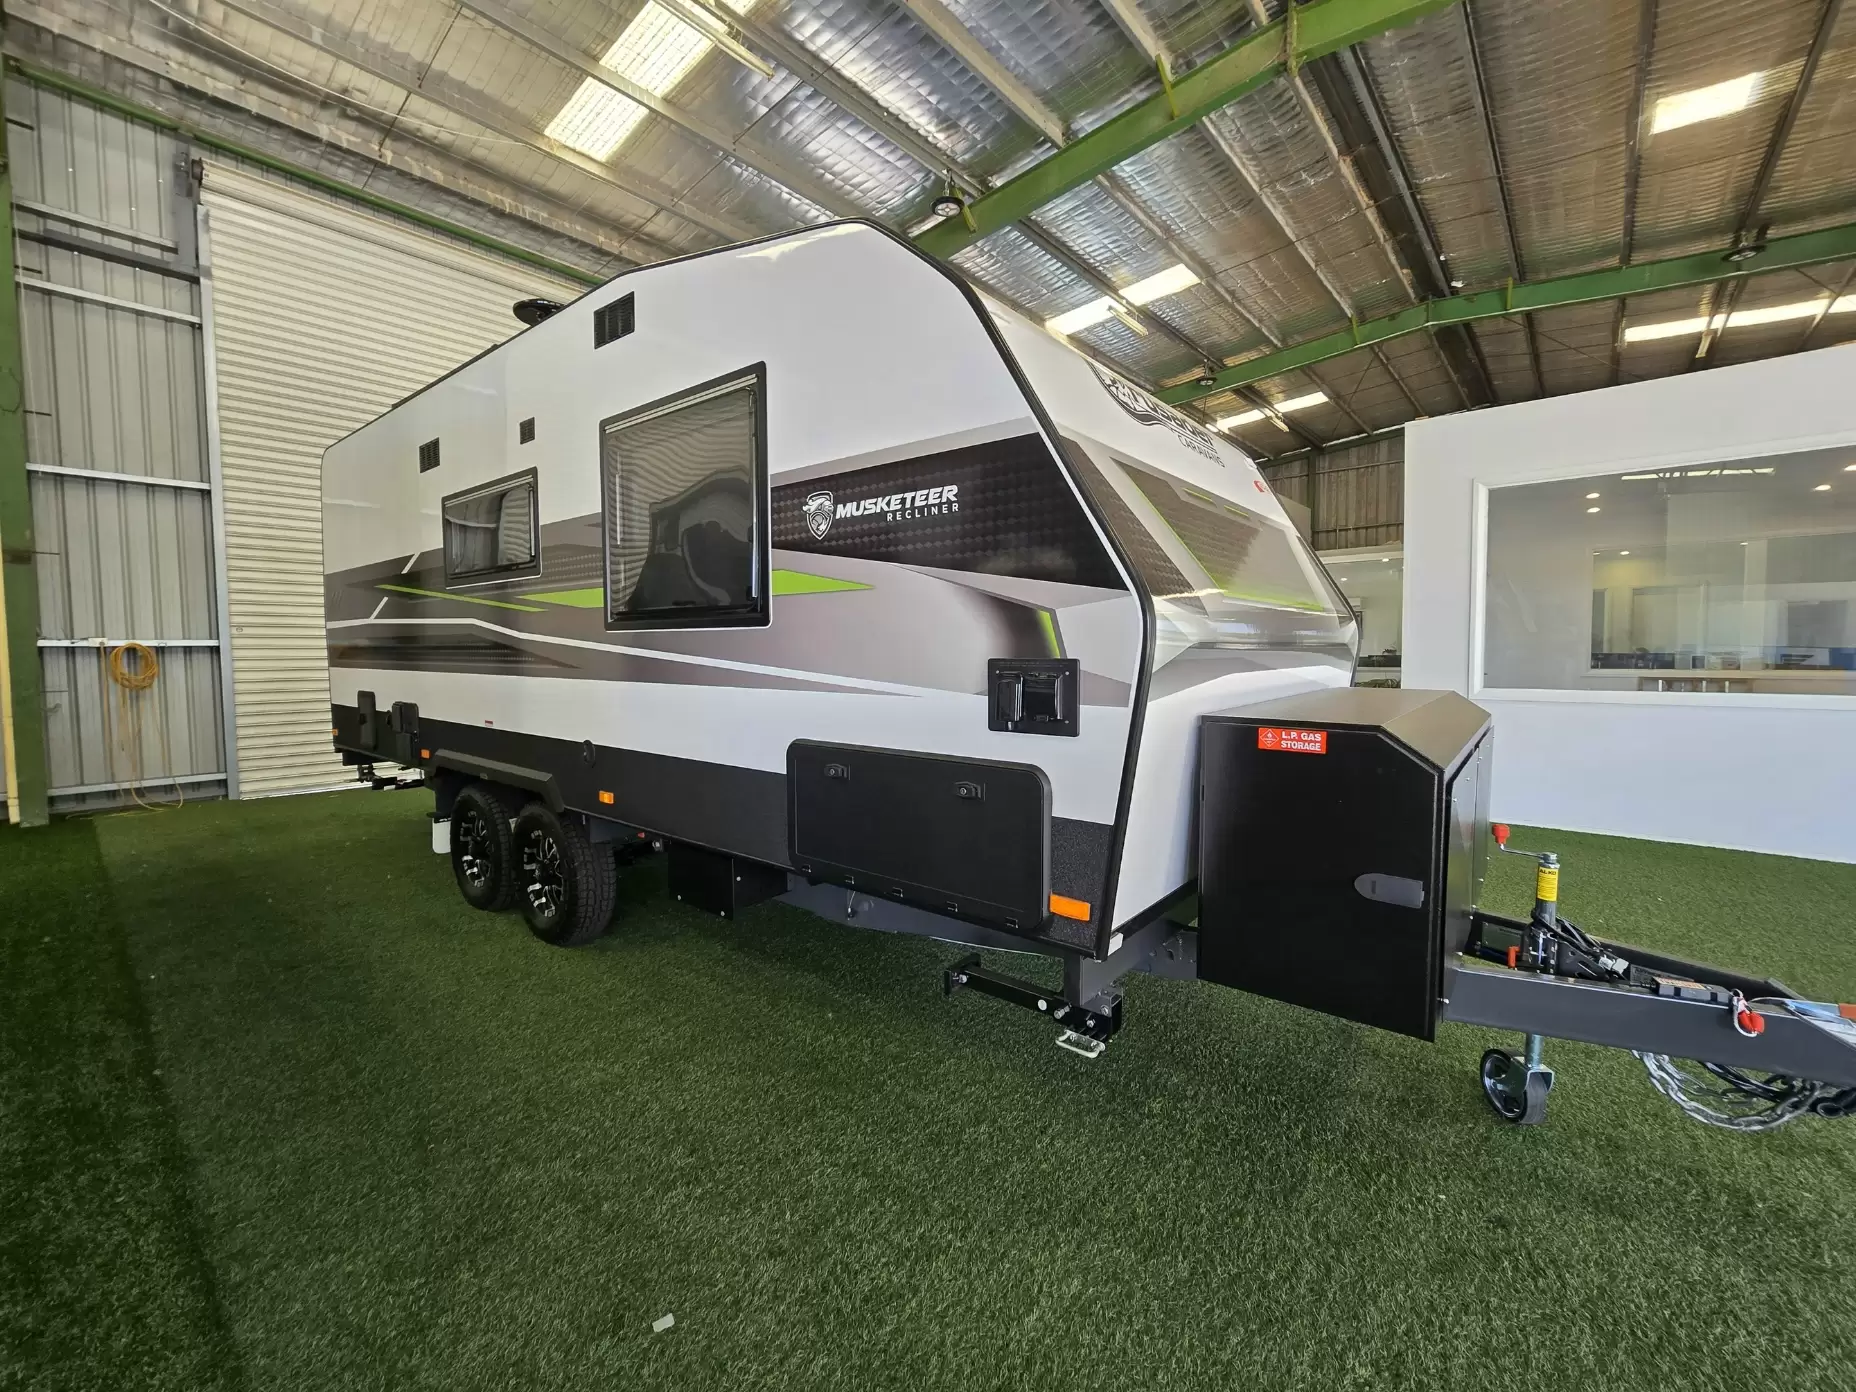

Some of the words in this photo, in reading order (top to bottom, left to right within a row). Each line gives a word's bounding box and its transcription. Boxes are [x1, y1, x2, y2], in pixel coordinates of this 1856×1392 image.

[835, 484, 959, 520] MUSKETEER
[886, 503, 960, 522] RECLINER
[1301, 732, 1322, 741] GAS
[1281, 741, 1322, 751] STORAGE
